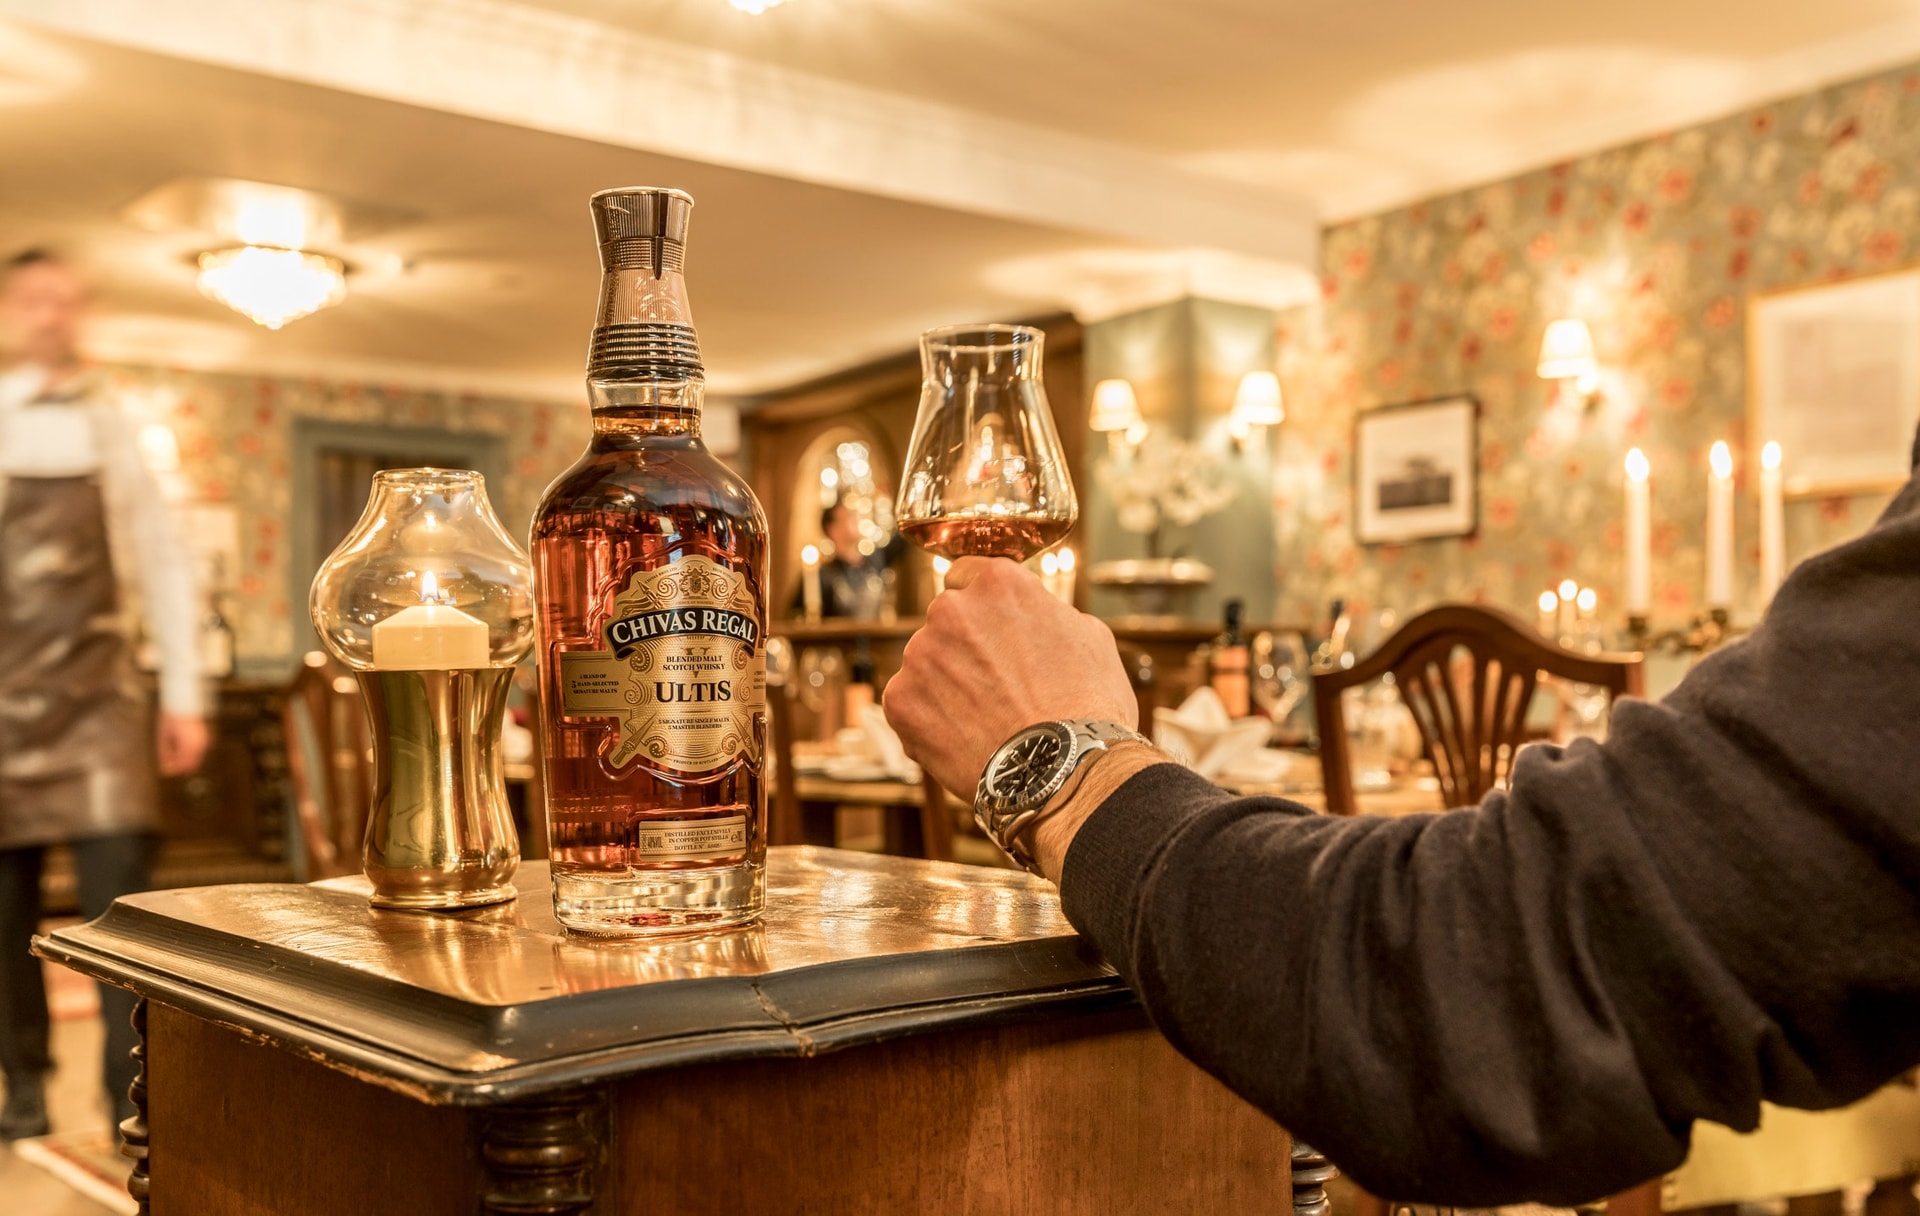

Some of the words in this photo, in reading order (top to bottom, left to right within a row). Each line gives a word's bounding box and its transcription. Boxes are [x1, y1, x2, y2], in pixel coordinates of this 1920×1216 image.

[612, 611, 697, 643] CHIVAS
[701, 609, 755, 642] REGAL
[666, 655, 703, 663] BLENDED
[571, 680, 577, 689] 5
[654, 680, 732, 703] ULTIS
[664, 830, 696, 838] DISTILLED
[696, 828, 731, 836] EXCLUSIVELY
[675, 836, 700, 844] COPPER
[710, 834, 729, 842] STILLS
